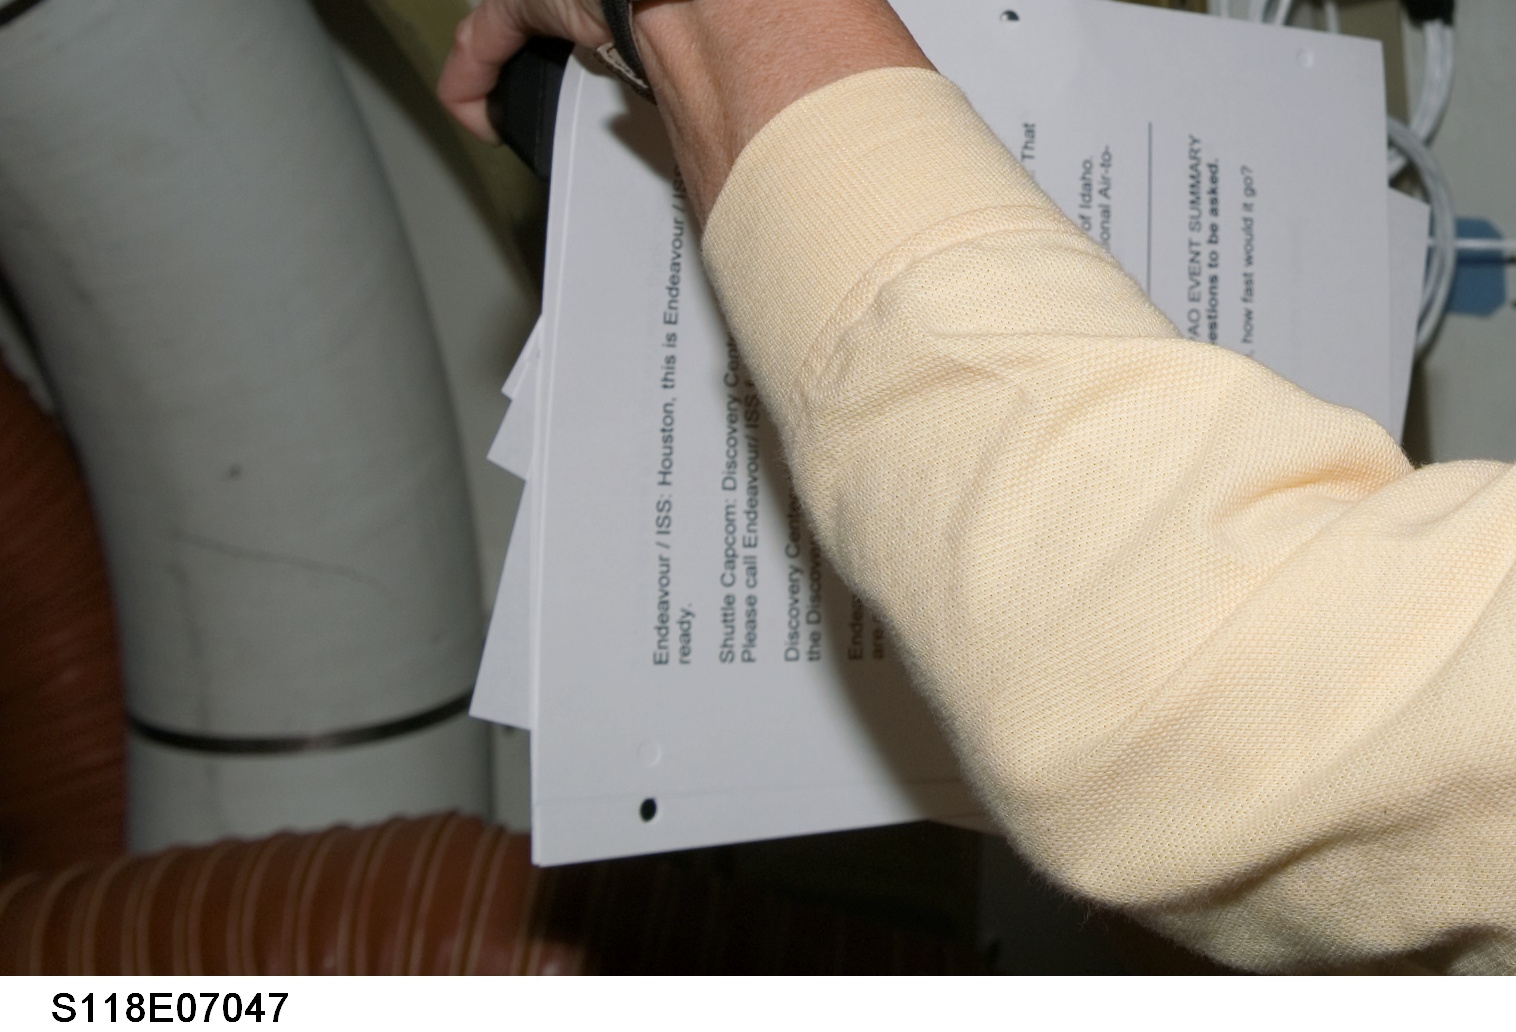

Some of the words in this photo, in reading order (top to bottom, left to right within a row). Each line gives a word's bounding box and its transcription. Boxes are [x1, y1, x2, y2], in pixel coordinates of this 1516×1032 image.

[1021, 122, 1036, 162] That
[1078, 156, 1094, 209] Idaho.
[1098, 144, 1112, 200] Air-to-
[1188, 134, 1202, 232] SUMMARY
[1206, 158, 1219, 217] asked.
[1240, 164, 1256, 198] go?
[1078, 214, 1092, 232] of
[1241, 202, 1254, 212] it
[1206, 223, 1219, 244] be
[1206, 250, 1219, 268] to
[1241, 216, 1254, 266] would
[664, 216, 685, 325] Endeavour
[1188, 238, 1201, 303] EVENT
[1241, 272, 1254, 303] fast
[1188, 308, 1201, 340] AO
[1206, 275, 1219, 345] estions
[1241, 308, 1254, 344] how
[662, 332, 678, 348] is
[660, 355, 676, 390] this
[744, 395, 759, 429] ISS
[657, 396, 677, 486] Houston,
[722, 394, 741, 492] Discovery
[656, 494, 672, 535] ISS:
[742, 436, 759, 548] Endeavour/
[720, 498, 739, 588] Capcom:
[742, 556, 758, 588] call
[653, 555, 671, 666] Endeavour
[677, 602, 695, 665] ready.
[719, 594, 736, 664] Shuttle
[741, 595, 757, 664] Please
[784, 564, 804, 662] Discovery
[848, 595, 864, 660] Endea
[806, 631, 822, 662] the
[870, 633, 884, 660] are
